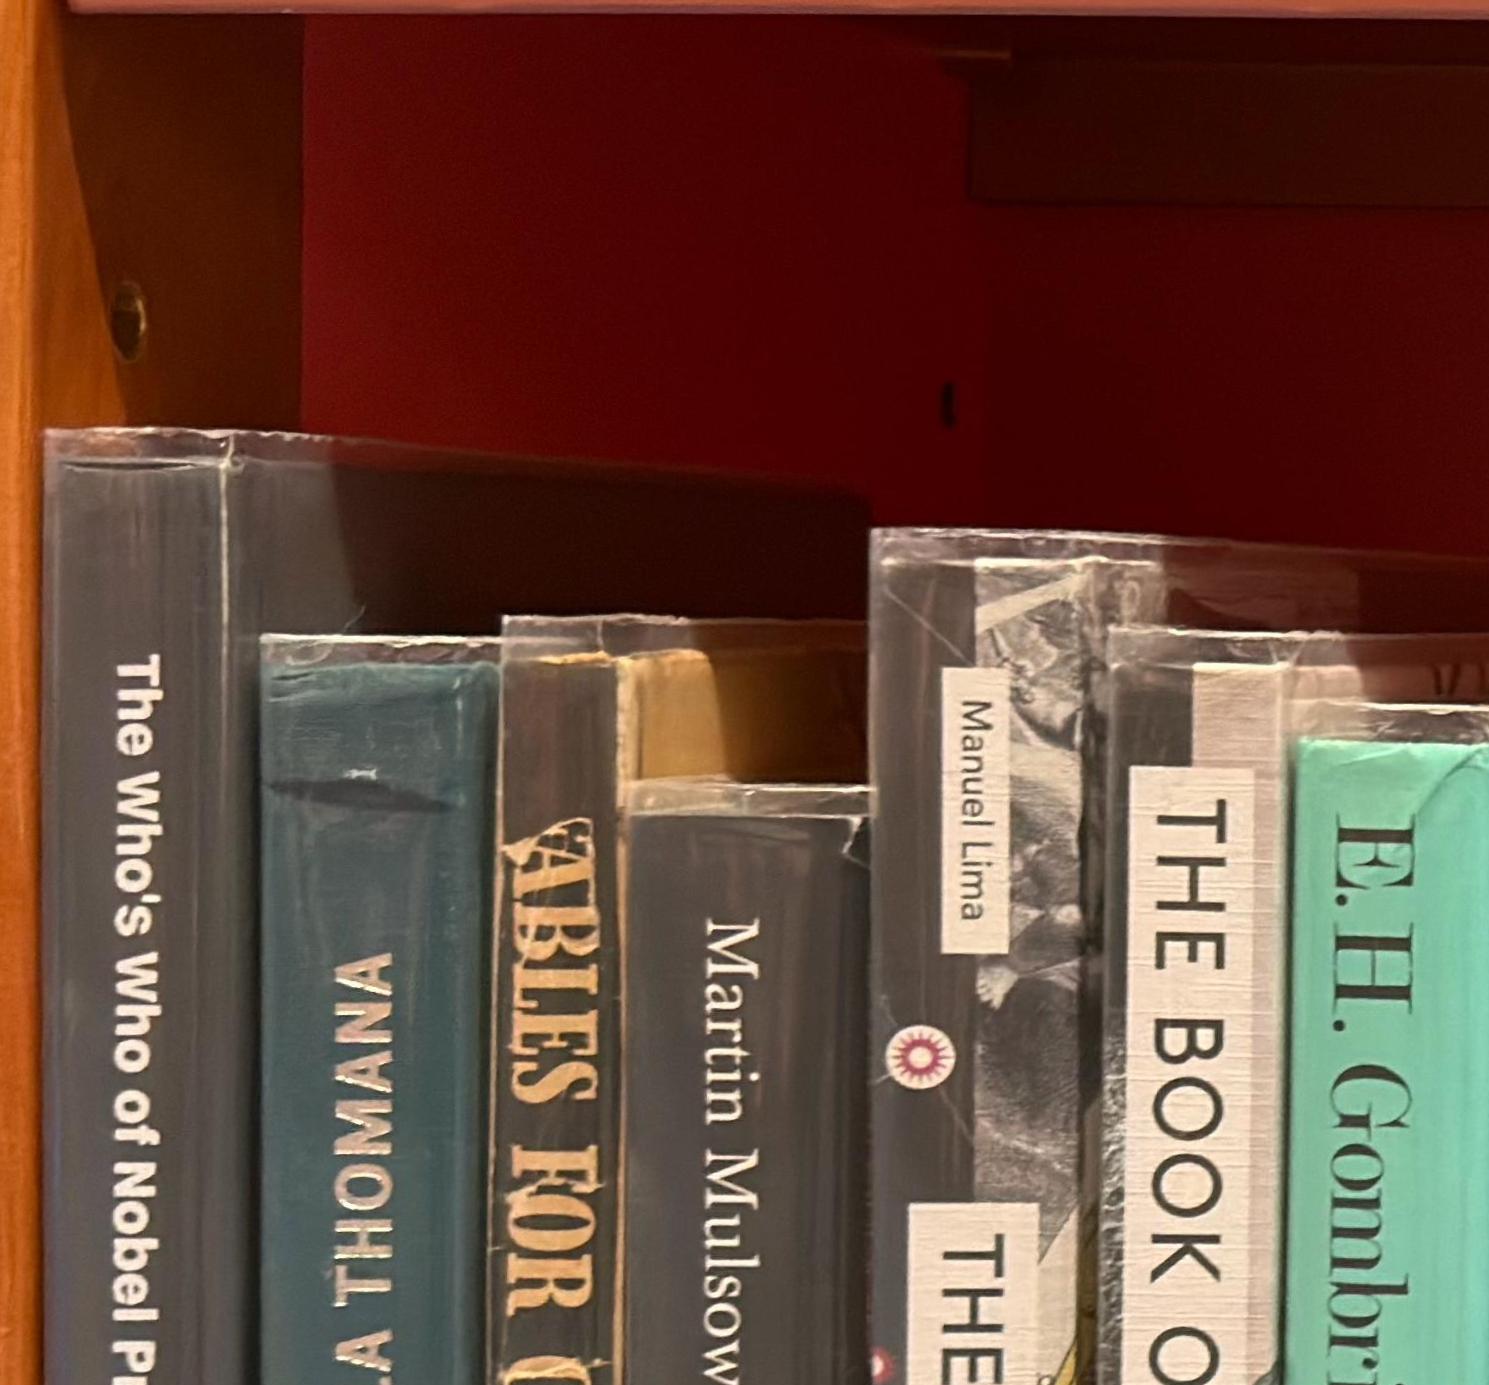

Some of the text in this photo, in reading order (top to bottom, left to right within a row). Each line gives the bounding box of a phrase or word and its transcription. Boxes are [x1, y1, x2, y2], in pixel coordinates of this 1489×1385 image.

[114, 653, 162, 757] The
[112, 770, 161, 935] Who's
[960, 700, 995, 921] Manuel Lima
[1154, 797, 1226, 971] THE
[1334, 812, 1418, 907] E.
[112, 951, 160, 1074] Who
[705, 918, 758, 1127] Martin
[1331, 923, 1414, 1033] H.
[112, 1087, 161, 1147] of
[334, 953, 392, 1308] THOMANA
[1150, 1017, 1224, 1284] BOOK
[110, 1159, 158, 1321] Nobel
[504, 1145, 600, 1317] FOR
